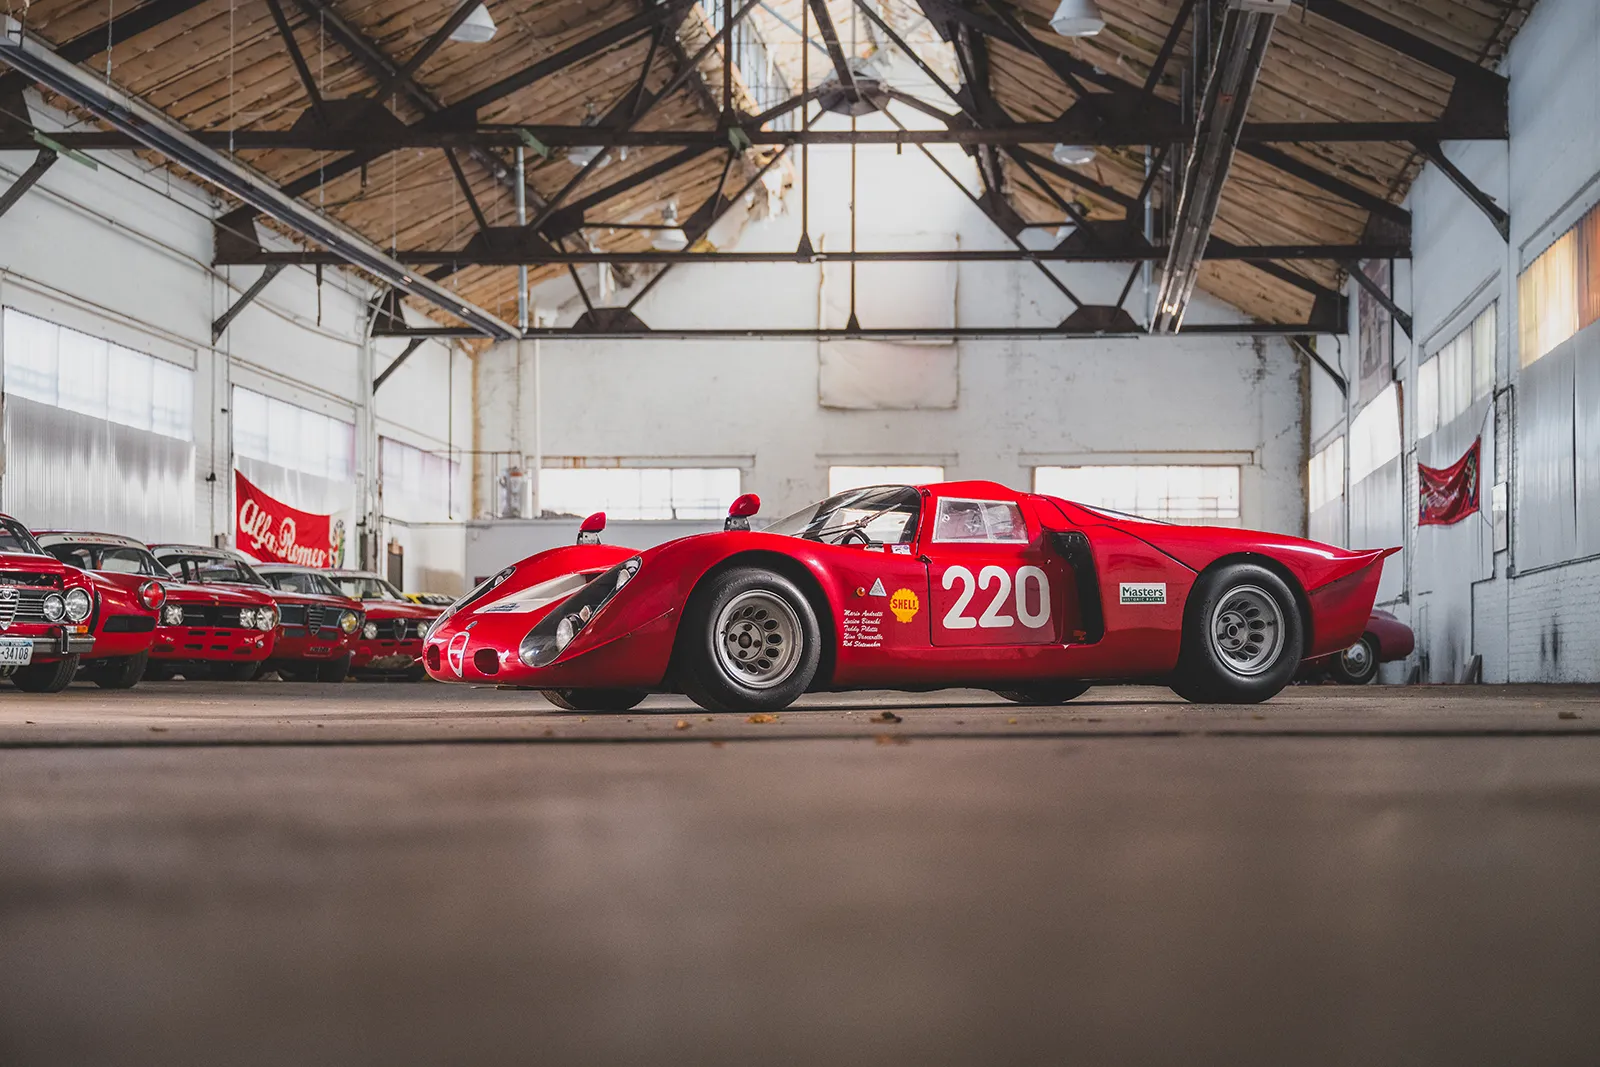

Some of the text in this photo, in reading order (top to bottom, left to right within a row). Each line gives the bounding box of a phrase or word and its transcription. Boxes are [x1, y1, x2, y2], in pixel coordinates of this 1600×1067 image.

[240, 499, 327, 567] Alfa Romeo
[942, 565, 1051, 629] 220
[1122, 586, 1163, 597] Masters
[892, 599, 917, 610] SHELL
[4, 647, 29, 660] 34108
